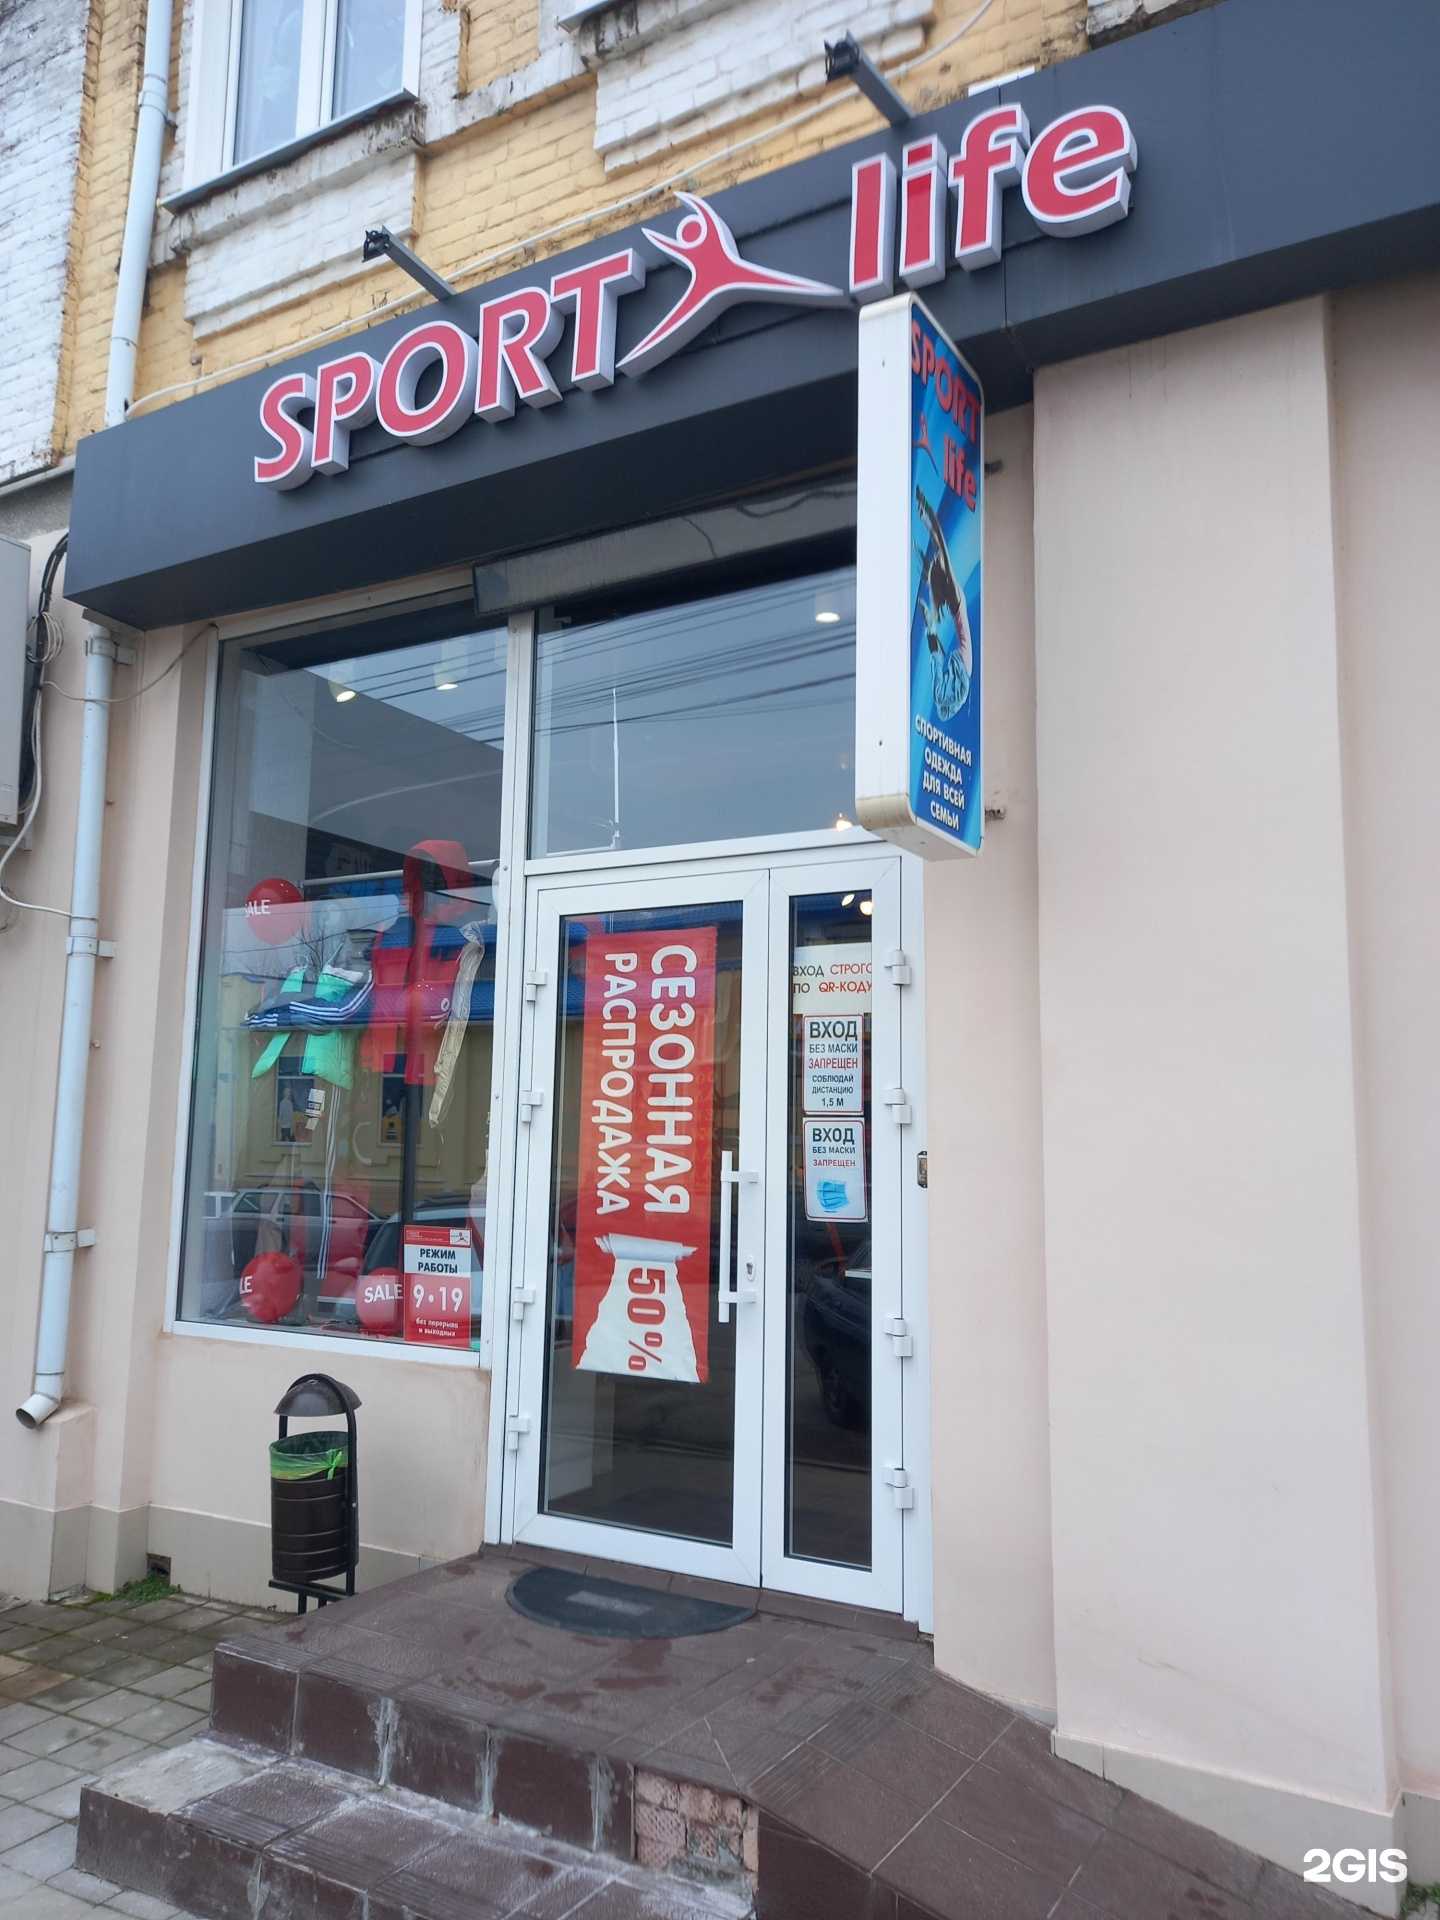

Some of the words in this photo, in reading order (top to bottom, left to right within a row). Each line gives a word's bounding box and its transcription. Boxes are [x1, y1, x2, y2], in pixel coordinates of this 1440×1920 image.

[254, 248, 638, 486] SPORT
[849, 103, 1134, 299] life
[911, 319, 982, 444] SPORT
[944, 432, 976, 512] life
[915, 714, 972, 766] СПОРТИВНАЯ
[925, 747, 962, 785] ОДЕЖДА
[923, 771, 941, 796] ДЛЯ
[943, 783, 965, 810] ВСЕЙ
[930, 801, 959, 831] СЕМЬИ
[793, 965, 824, 977] ВХОД
[793, 983, 810, 993] ПО
[809, 1020, 858, 1041] ВХОД
[809, 1043, 826, 1053] БЕЗ
[828, 1043, 858, 1053] МАСКИ
[808, 1057, 858, 1070] ЗАПРЕЩЕН
[592, 952, 638, 1215] РАСПРОДАЖА
[643, 944, 698, 1214] СЕЗОННАЯ
[812, 1073, 854, 1083] СОБЛЮДАЙ
[812, 1086, 854, 1095] ДИСТАНЦИЮ
[821, 1097, 834, 1107] 1,5
[836, 1097, 844, 1107] М
[812, 1127, 855, 1145] ВХОД
[812, 1146, 827, 1154] БЕЗ
[828, 1146, 856, 1154] МАСКИ
[813, 1159, 856, 1168] ЗАПРЕЩЕН
[419, 1248, 456, 1260] РЕЖИМ
[417, 1261, 458, 1274] РАБОТЫ
[364, 1283, 404, 1304] SALE
[627, 1267, 666, 1371] 50%
